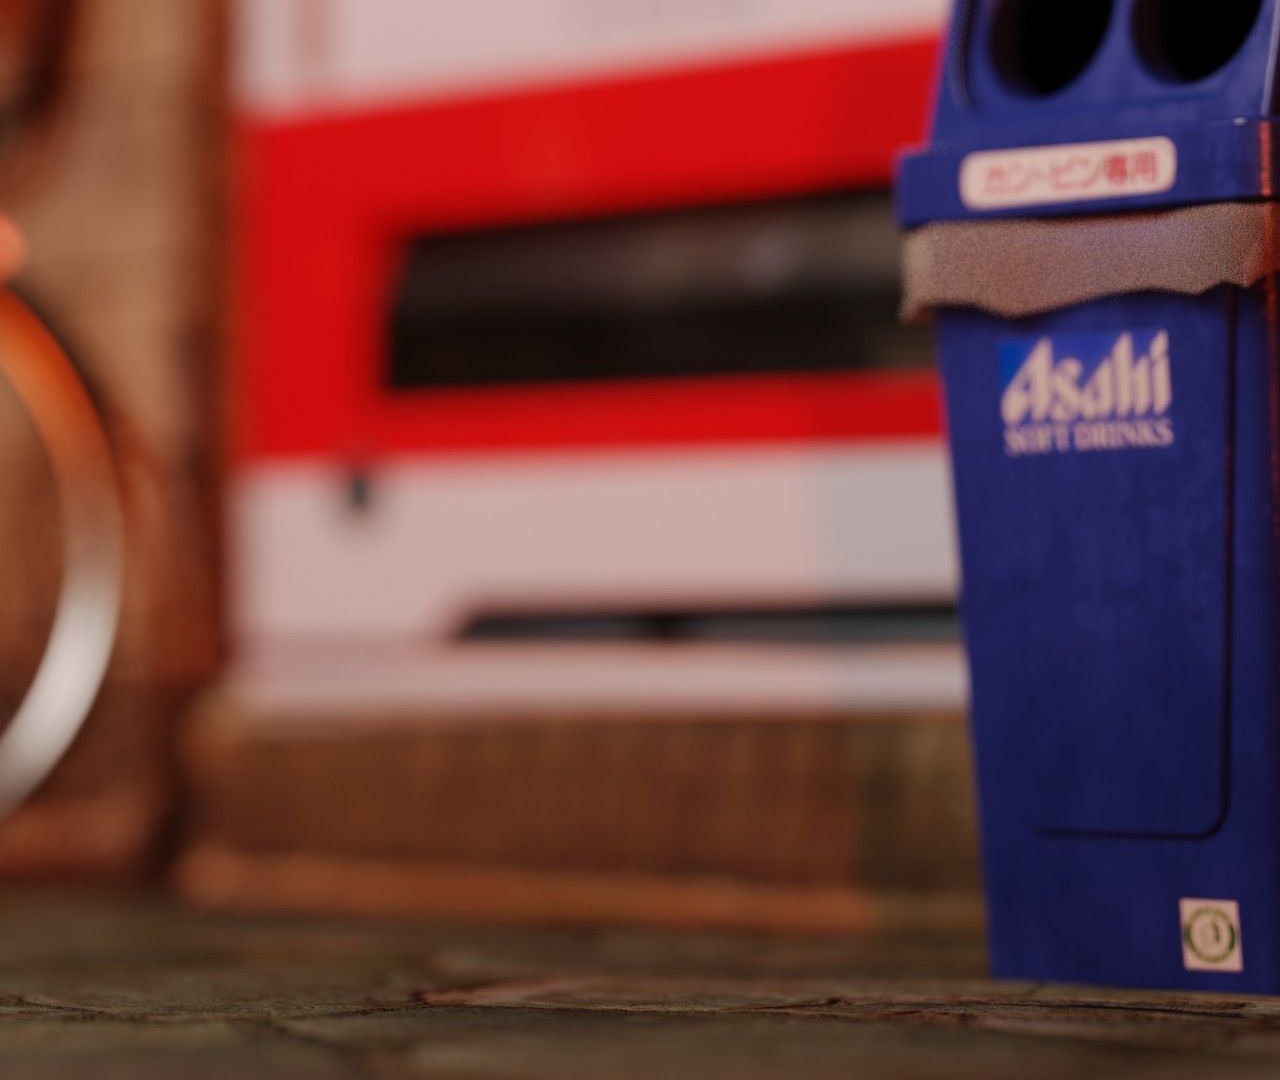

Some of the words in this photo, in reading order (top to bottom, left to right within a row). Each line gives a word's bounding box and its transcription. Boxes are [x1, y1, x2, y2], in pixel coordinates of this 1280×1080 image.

[1001, 329, 1172, 425] Asahi
[1004, 422, 1069, 457] SOFT
[1074, 418, 1174, 453] DRINKS
